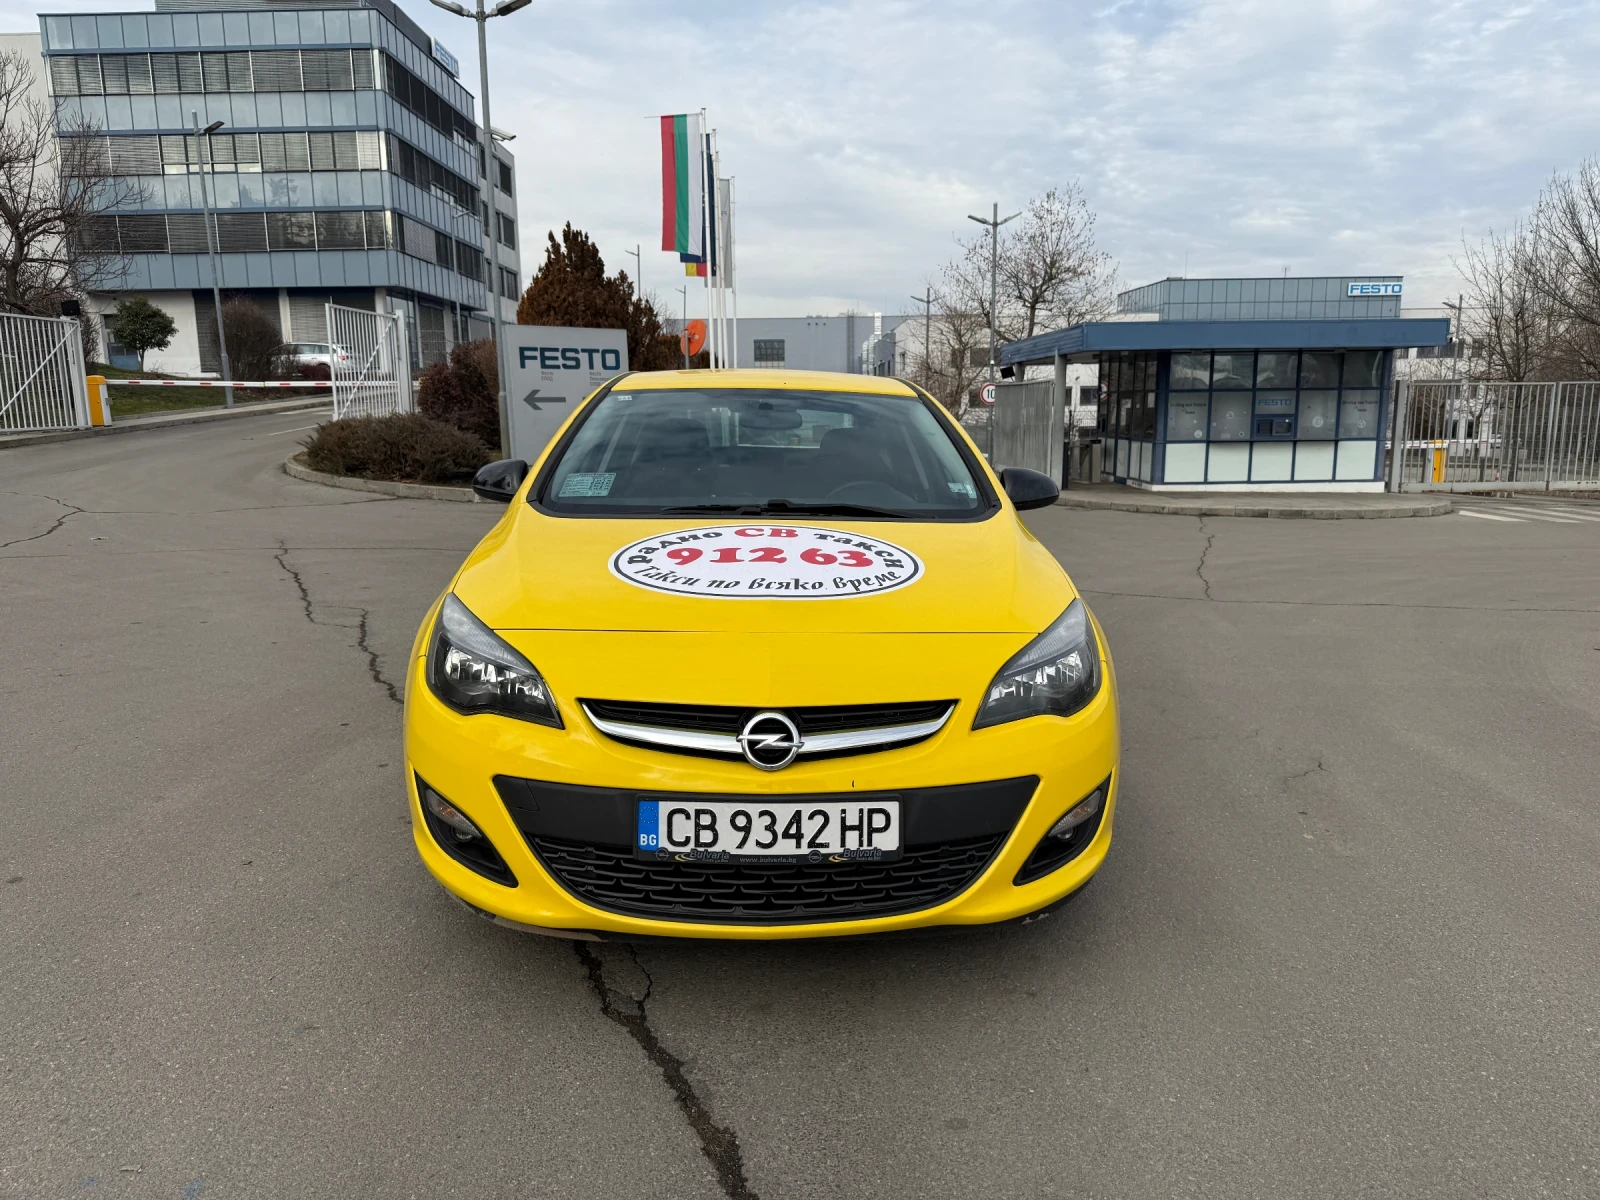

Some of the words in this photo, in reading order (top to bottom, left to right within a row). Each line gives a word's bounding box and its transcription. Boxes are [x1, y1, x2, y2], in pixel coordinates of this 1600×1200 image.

[1350, 283, 1403, 294] FESTO
[519, 346, 620, 370] FESTO
[1257, 399, 1292, 407] FESTO
[666, 547, 788, 566] 912
[800, 547, 874, 568] 63
[634, 565, 701, 586] Такси
[707, 579, 741, 589] по
[748, 577, 824, 590] всяко
[832, 571, 902, 592] време
[667, 807, 719, 848] CB
[729, 809, 831, 849] 9342
[840, 807, 892, 848] HP
[640, 834, 657, 846] BG
[689, 849, 730, 860] Bulvaria
[843, 848, 882, 859] Bulvaria
